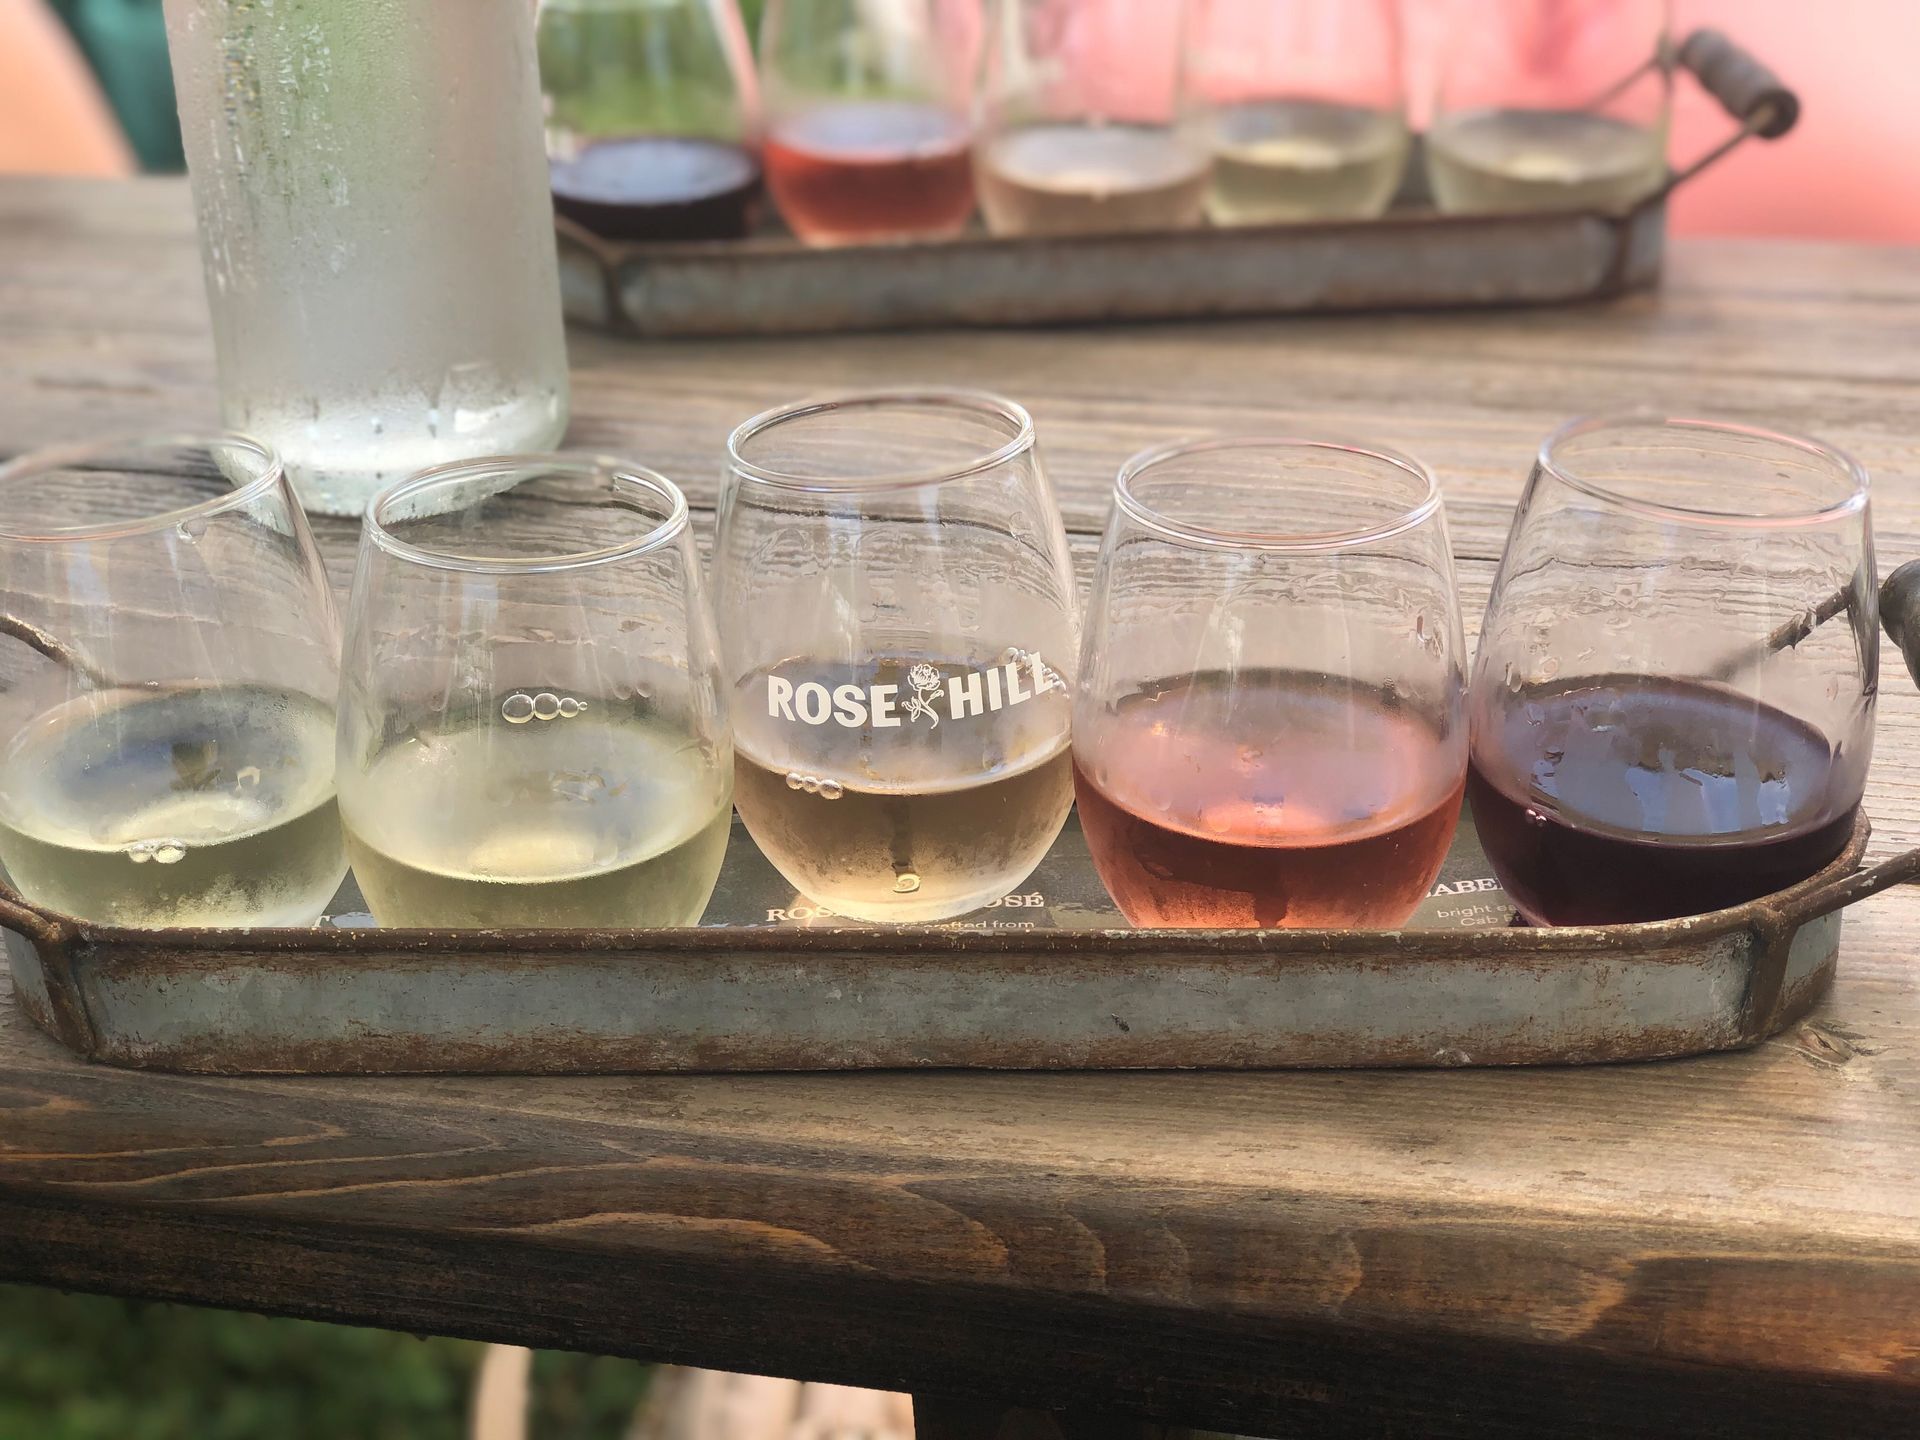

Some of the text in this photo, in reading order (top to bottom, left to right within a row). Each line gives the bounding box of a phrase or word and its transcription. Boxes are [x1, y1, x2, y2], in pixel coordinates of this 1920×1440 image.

[767, 651, 1054, 728] ROSE HILL
[1425, 877, 1504, 898] ABE
[765, 906, 836, 922] ROS
[1436, 904, 1492, 918] bright
[992, 919, 1035, 928] from
[1460, 915, 1498, 926] Cab
